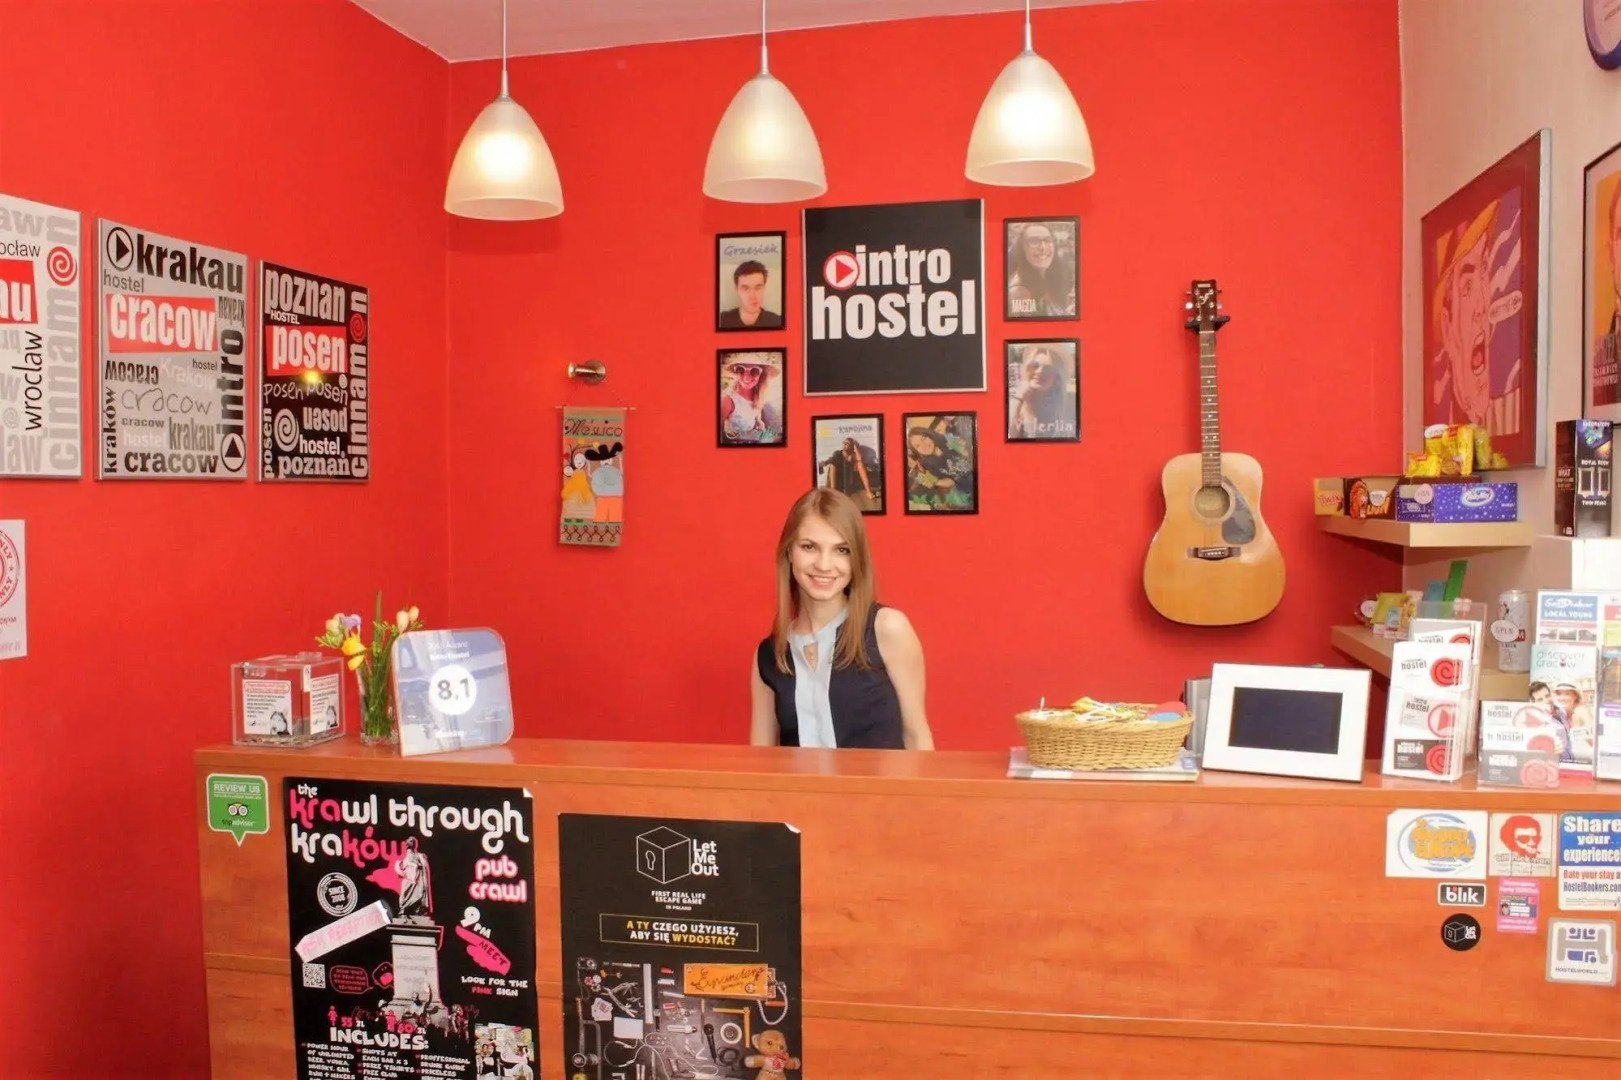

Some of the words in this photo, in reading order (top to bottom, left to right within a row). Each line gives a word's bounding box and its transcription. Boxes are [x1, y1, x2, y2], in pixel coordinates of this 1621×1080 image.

[136, 233, 244, 294] krakau
[856, 244, 951, 287] intro
[103, 269, 145, 294] hostel
[264, 269, 346, 324] poznan
[1011, 298, 1037, 313] MAGDA
[270, 310, 300, 325] HOSTEL
[811, 280, 977, 340] hostel
[109, 294, 217, 351] cracow
[272, 326, 347, 374] posen
[105, 360, 159, 386] cracow
[193, 358, 218, 372] hostel
[12, 331, 43, 431] wroclaw
[216, 329, 244, 435] intro
[121, 388, 212, 415] cracow
[263, 382, 304, 405] posen
[306, 380, 348, 406] posen
[121, 417, 165, 429] cracow
[169, 416, 215, 451] krakau
[263, 408, 275, 479] posen
[300, 434, 340, 455] hostel
[124, 451, 219, 473] cracow
[1401, 661, 1427, 670] hostel
[1406, 701, 1430, 712] hostel
[213, 783, 246, 793] REVIEW
[248, 784, 261, 794] US
[297, 783, 318, 797] the
[289, 788, 378, 829] krawl
[389, 795, 530, 854] through
[1563, 815, 1621, 833] Share
[291, 823, 409, 868] kraków
[692, 838, 717, 853] Let
[1577, 835, 1611, 846] your
[475, 854, 519, 881] pub
[694, 852, 716, 865] Me
[691, 863, 720, 877] Out
[1563, 870, 1580, 880] Rate
[1581, 871, 1598, 881] your
[1599, 869, 1615, 880] stay
[469, 880, 527, 904] crawl
[651, 890, 670, 898] FIRST
[672, 891, 689, 899] REAL
[691, 892, 706, 900] LIFE
[655, 896, 680, 904] ESCAPE
[1446, 886, 1479, 903] blik
[473, 922, 492, 938] PM
[626, 920, 634, 930] A
[635, 920, 650, 931] TY
[652, 921, 688, 933] CZEGO
[690, 922, 740, 937] UŻYJESZ,
[630, 929, 651, 940] ABY
[653, 931, 670, 944] SIĘ
[672, 933, 737, 946] WYDOSTAĆ?
[478, 940, 508, 967] MEET
[461, 975, 485, 985] LOOK
[489, 977, 505, 987] FOR
[509, 979, 528, 988] THE
[472, 986, 493, 995] PINK
[496, 988, 518, 997] SIGN
[330, 1026, 429, 1051] INCLUDES:
